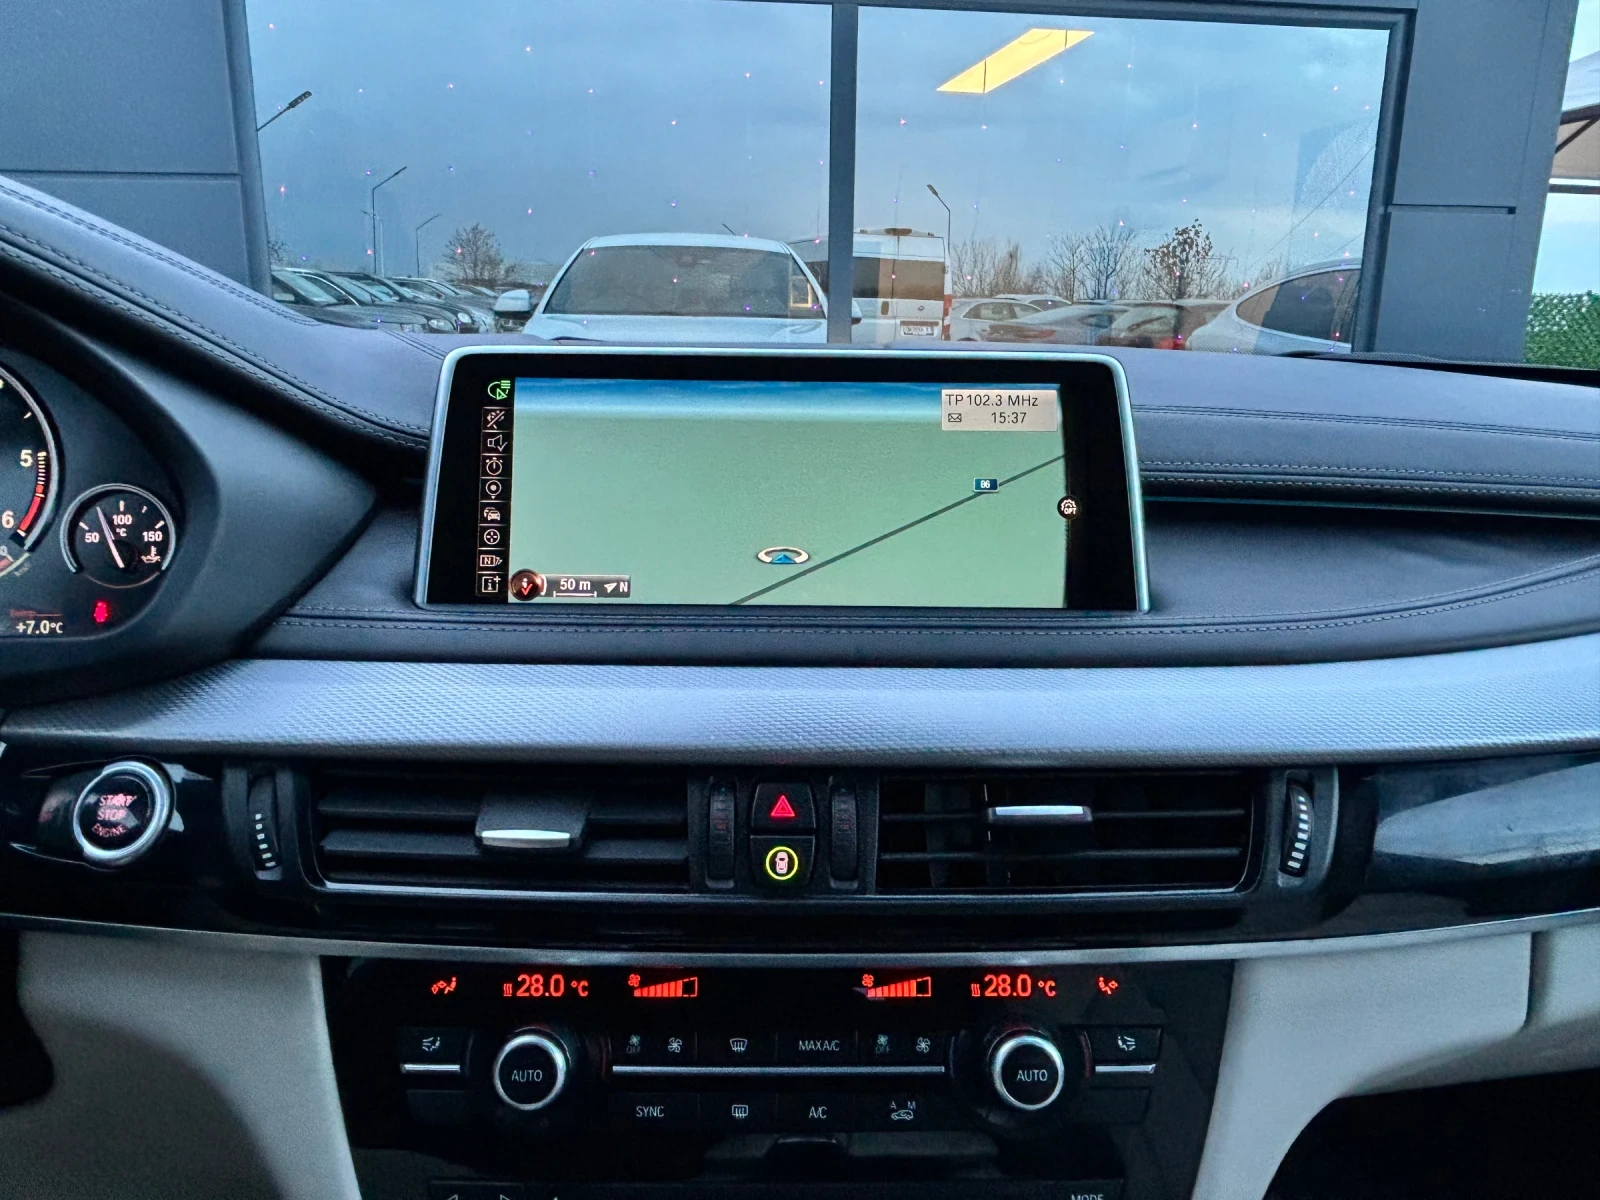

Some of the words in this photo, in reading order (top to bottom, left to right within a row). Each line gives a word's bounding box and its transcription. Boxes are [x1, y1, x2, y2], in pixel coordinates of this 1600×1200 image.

[945, 394, 964, 406] TP
[966, 394, 1003, 406] 102.3
[1007, 394, 1039, 407] MHz
[991, 411, 1027, 424] 15:37
[19, 449, 33, 468] 5
[1, 511, 15, 529] 6
[112, 514, 133, 525] 100
[84, 532, 100, 543] 50
[142, 531, 163, 543] 150
[559, 578, 576, 590] 50
[579, 580, 591, 591] m
[619, 582, 628, 593] N
[97, 809, 127, 821] STOP
[516, 973, 565, 998] 28.0
[984, 973, 1032, 997] 28.0
[798, 1040, 822, 1051] MAX
[822, 1040, 840, 1051] A/C
[511, 1069, 543, 1082] AUTO
[1016, 1069, 1048, 1082] AUTO
[636, 1105, 665, 1118] SYNC
[808, 1106, 828, 1119] A/C
